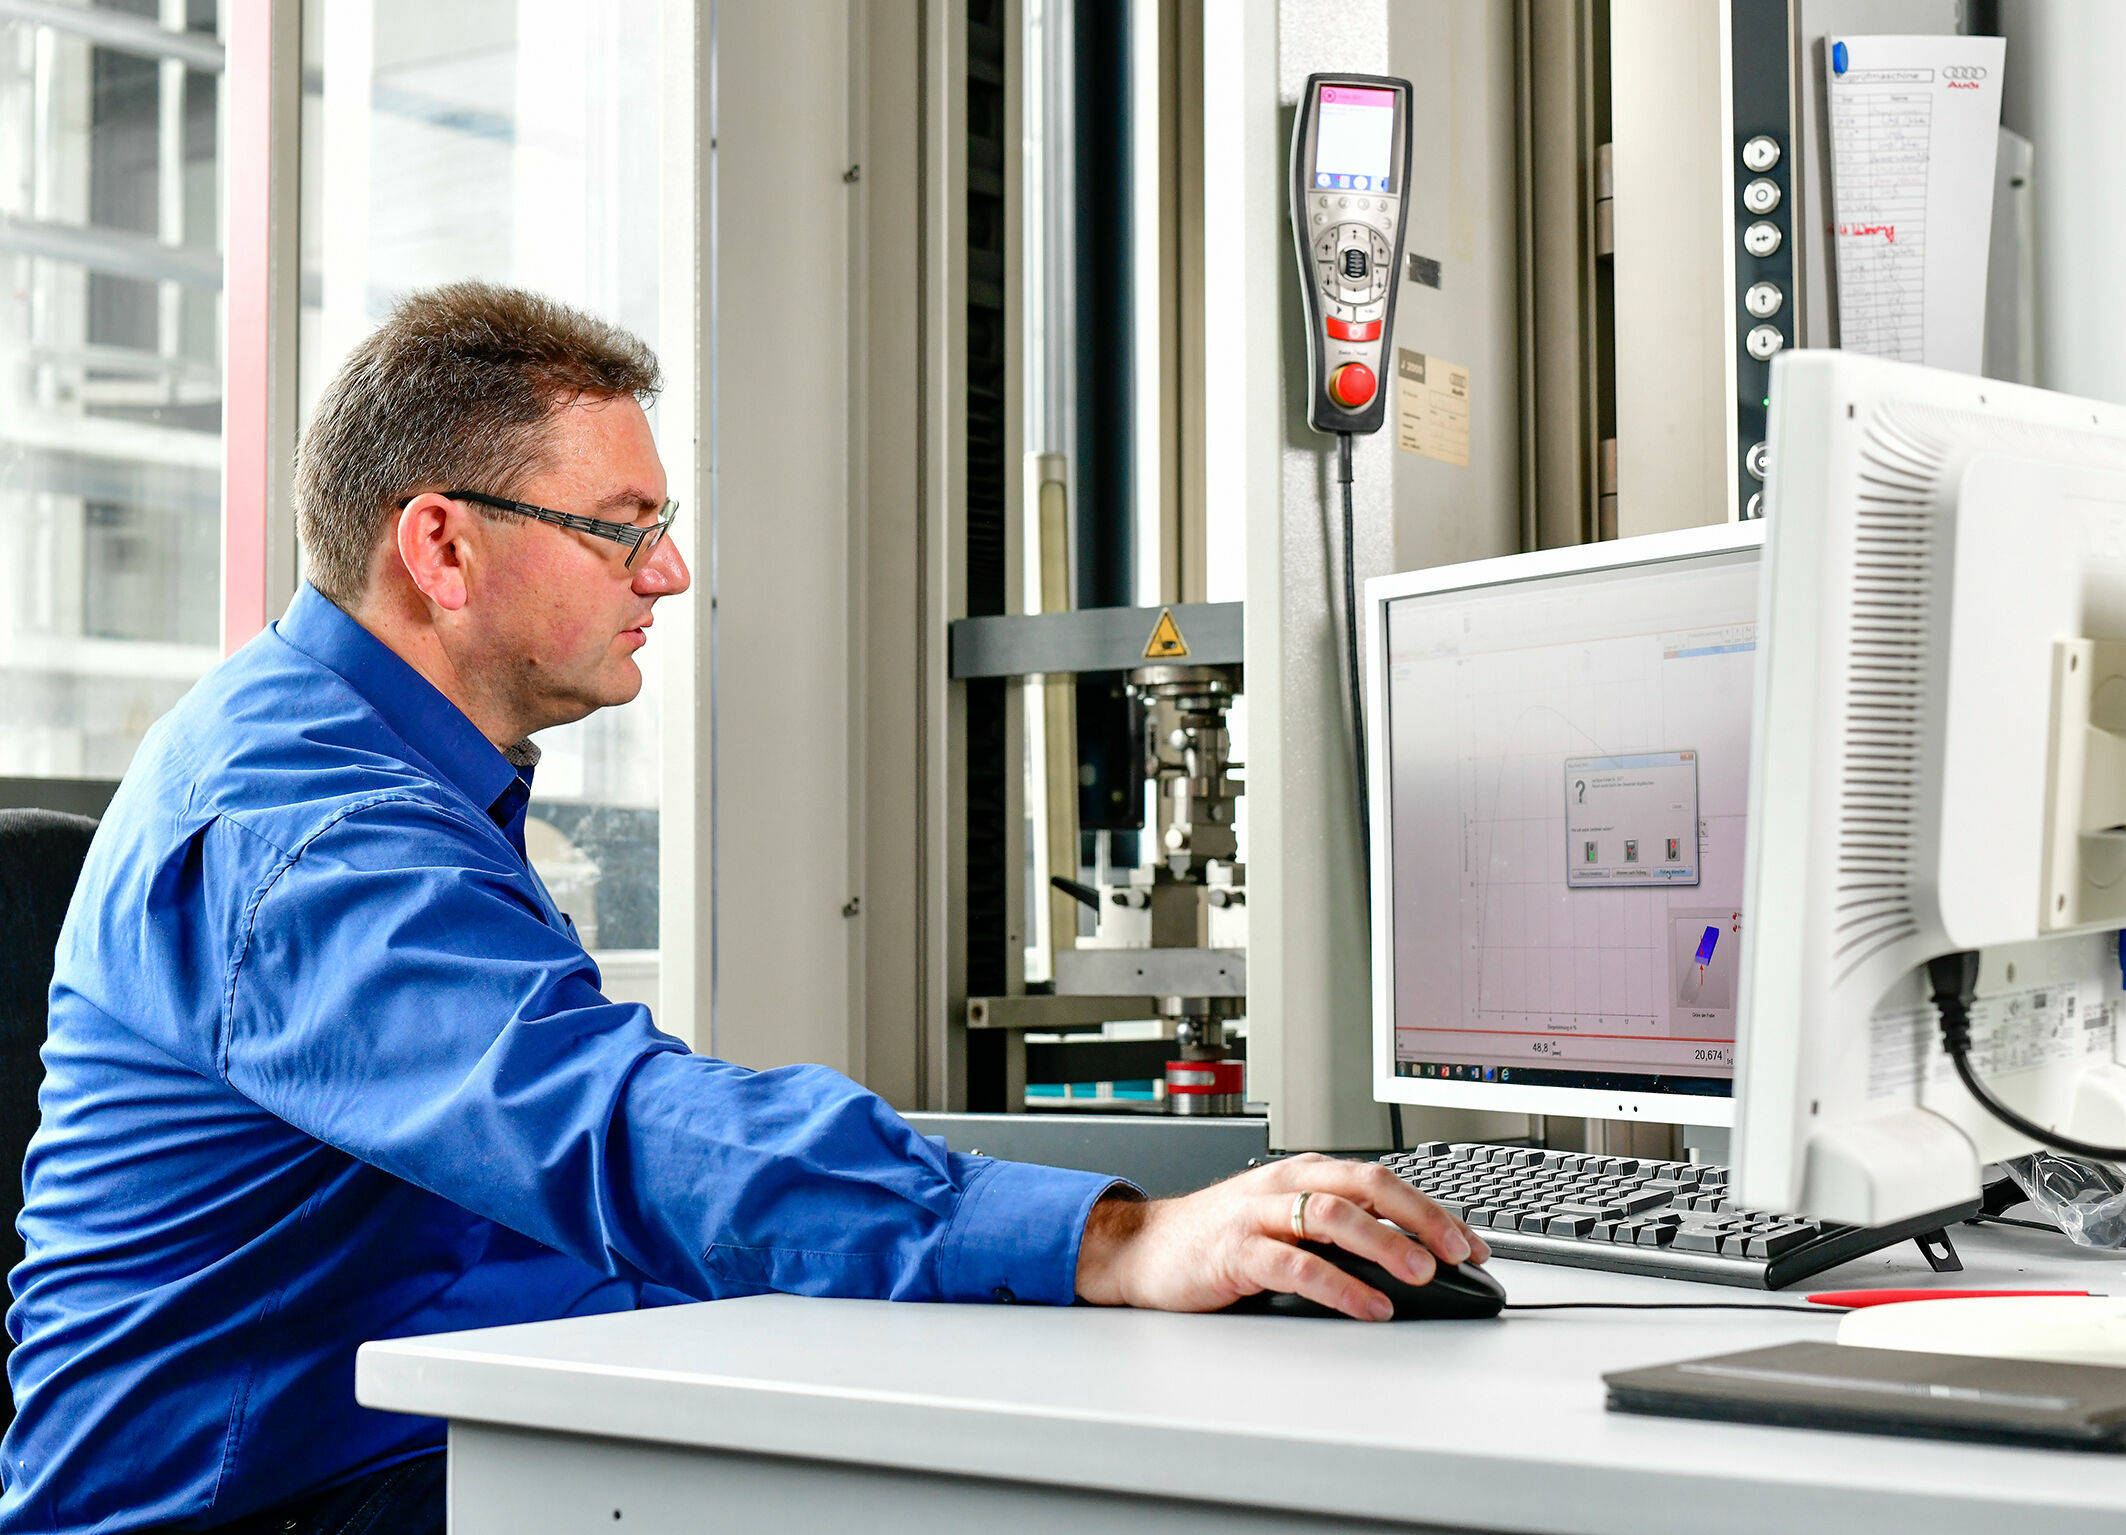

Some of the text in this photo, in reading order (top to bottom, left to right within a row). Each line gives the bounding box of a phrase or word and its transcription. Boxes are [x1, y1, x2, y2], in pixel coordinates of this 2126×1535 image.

[1947, 81, 1979, 89] Audi
[1532, 1042, 1549, 1054] 48,8
[1694, 1049, 1723, 1062] 20,674
